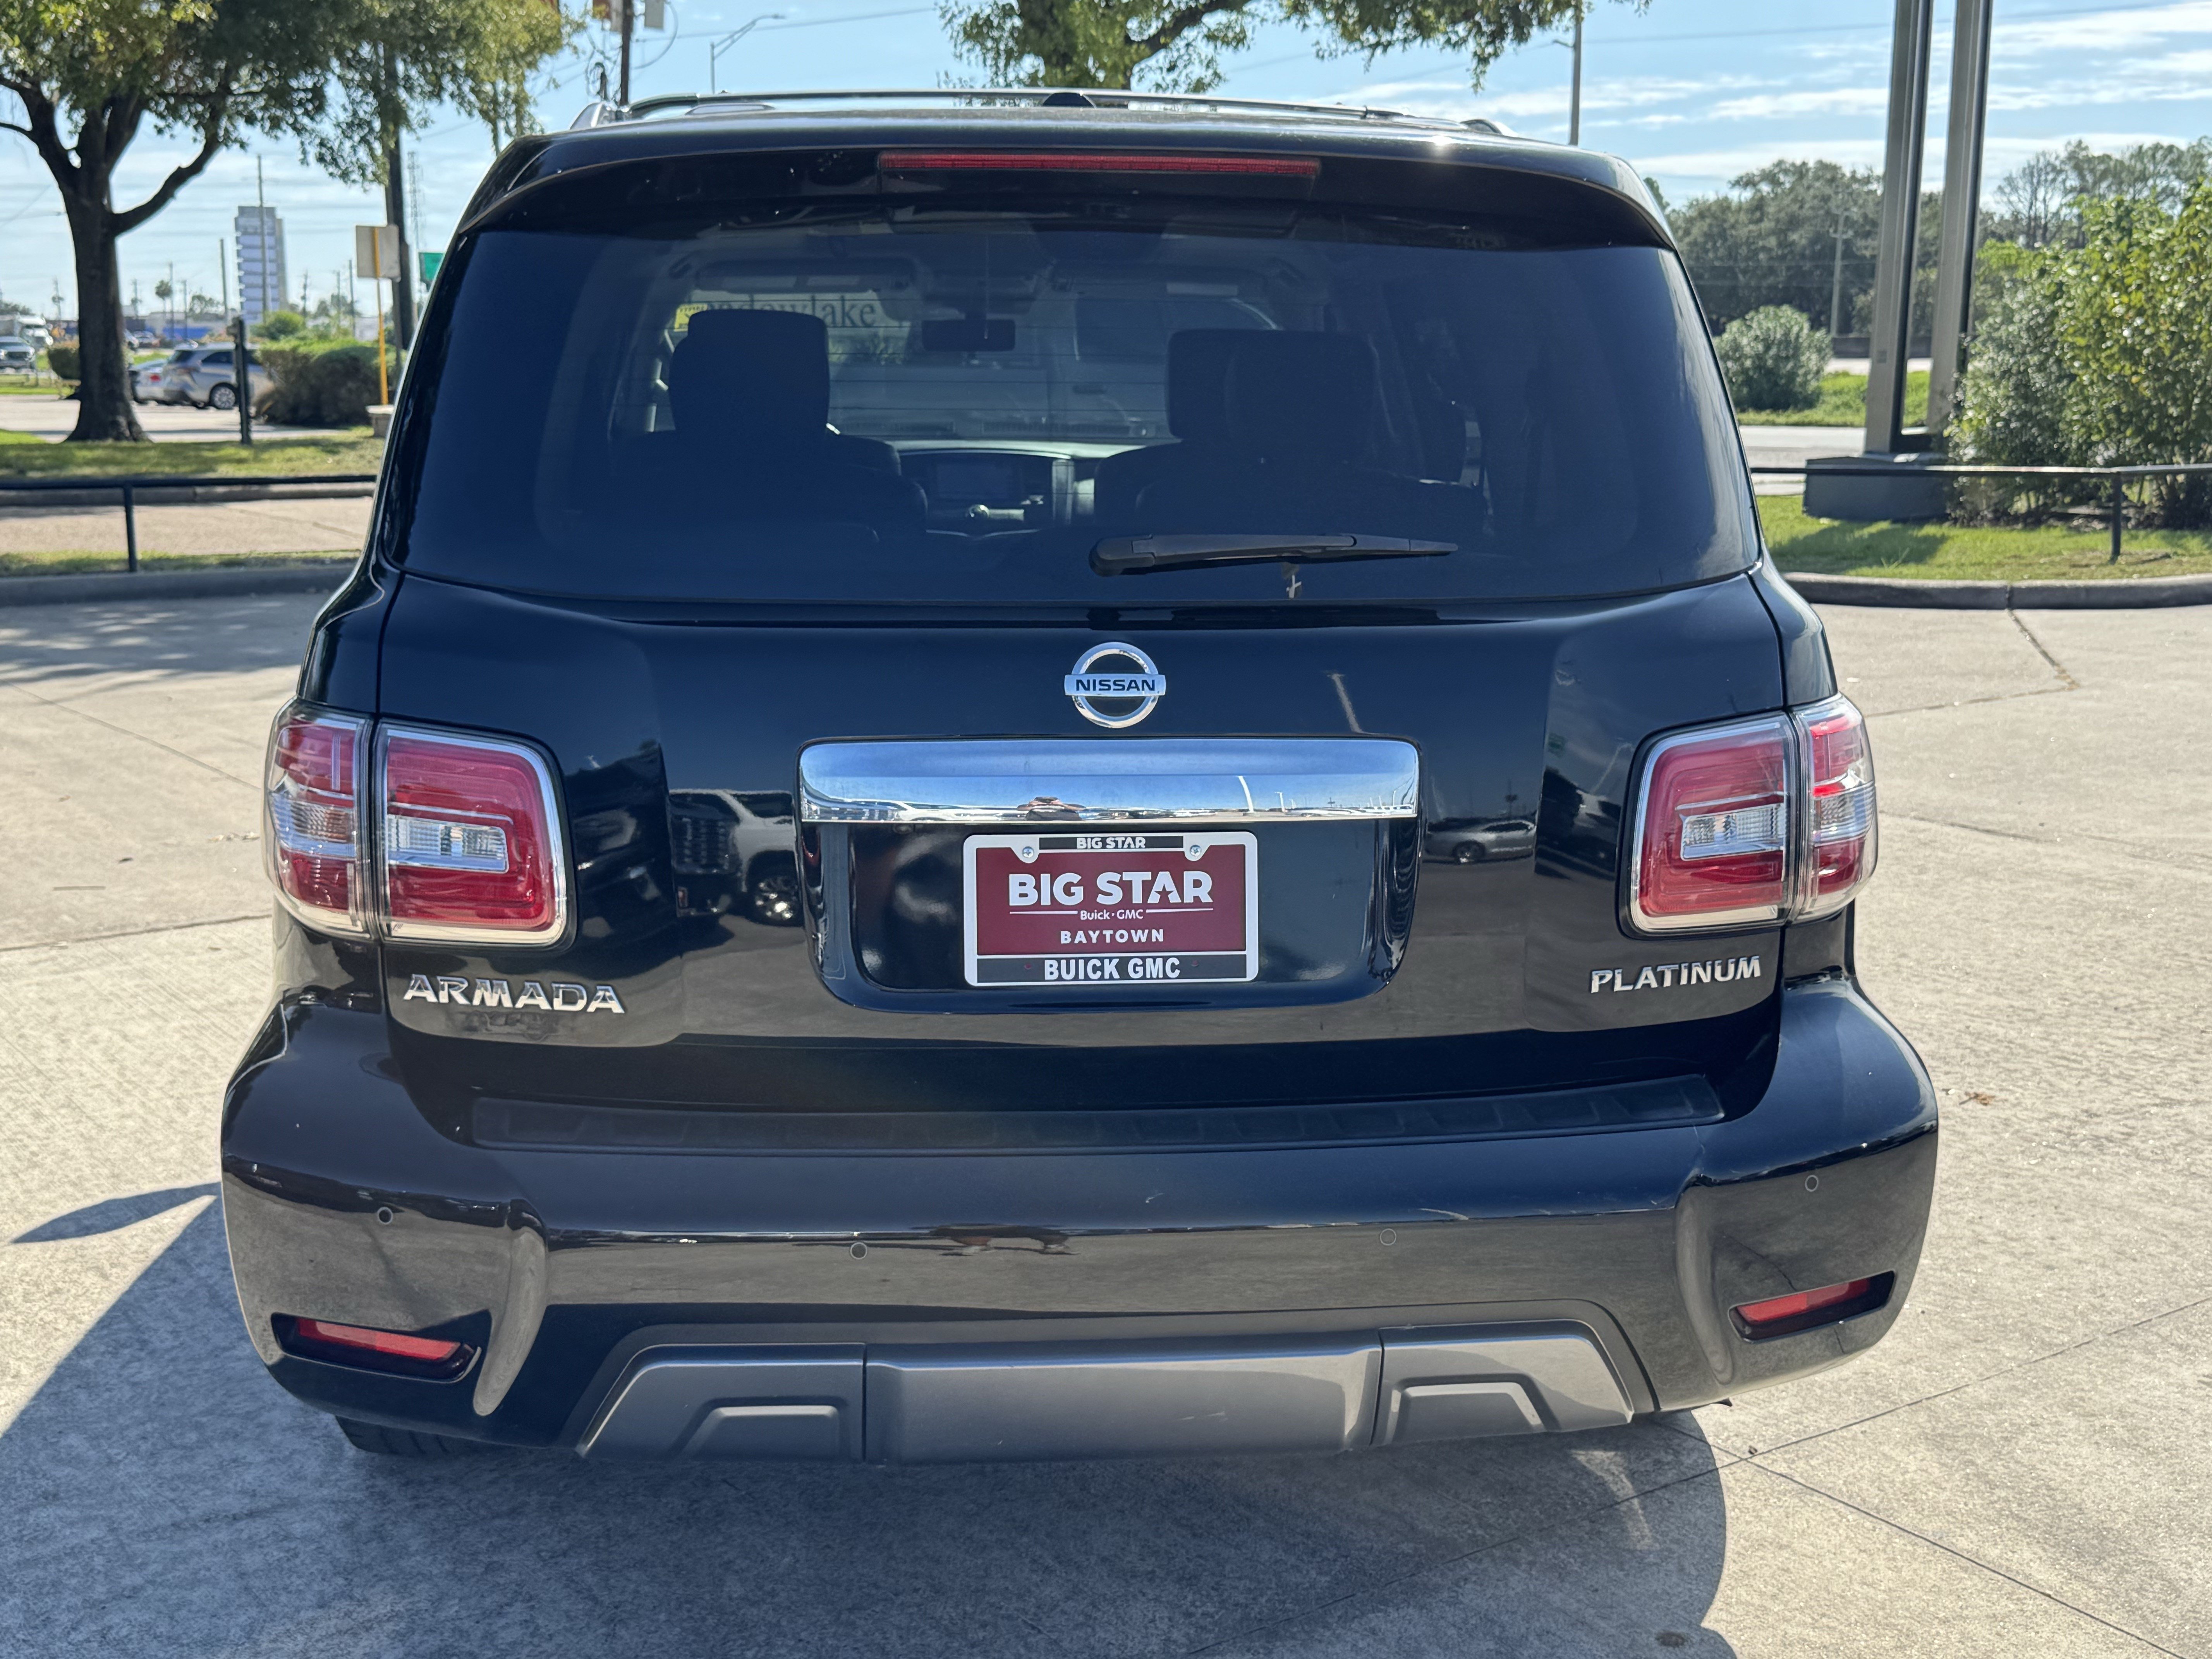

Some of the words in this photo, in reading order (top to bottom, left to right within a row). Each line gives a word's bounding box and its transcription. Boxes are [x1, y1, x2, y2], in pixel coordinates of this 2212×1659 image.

[1076, 679, 1155, 691] NISSAN
[1076, 837, 1103, 849] BIG
[1106, 836, 1146, 848] STAR
[1008, 872, 1084, 906] BIG
[1096, 871, 1213, 905] STAR
[1080, 910, 1110, 920] Buick
[1116, 909, 1144, 920] GMC
[1060, 929, 1164, 944] BAYTOWN
[1044, 958, 1120, 980] BUICK
[1127, 957, 1180, 979] GMC
[1590, 955, 1761, 994] PLATINUM
[403, 973, 625, 1014] ARMADA
